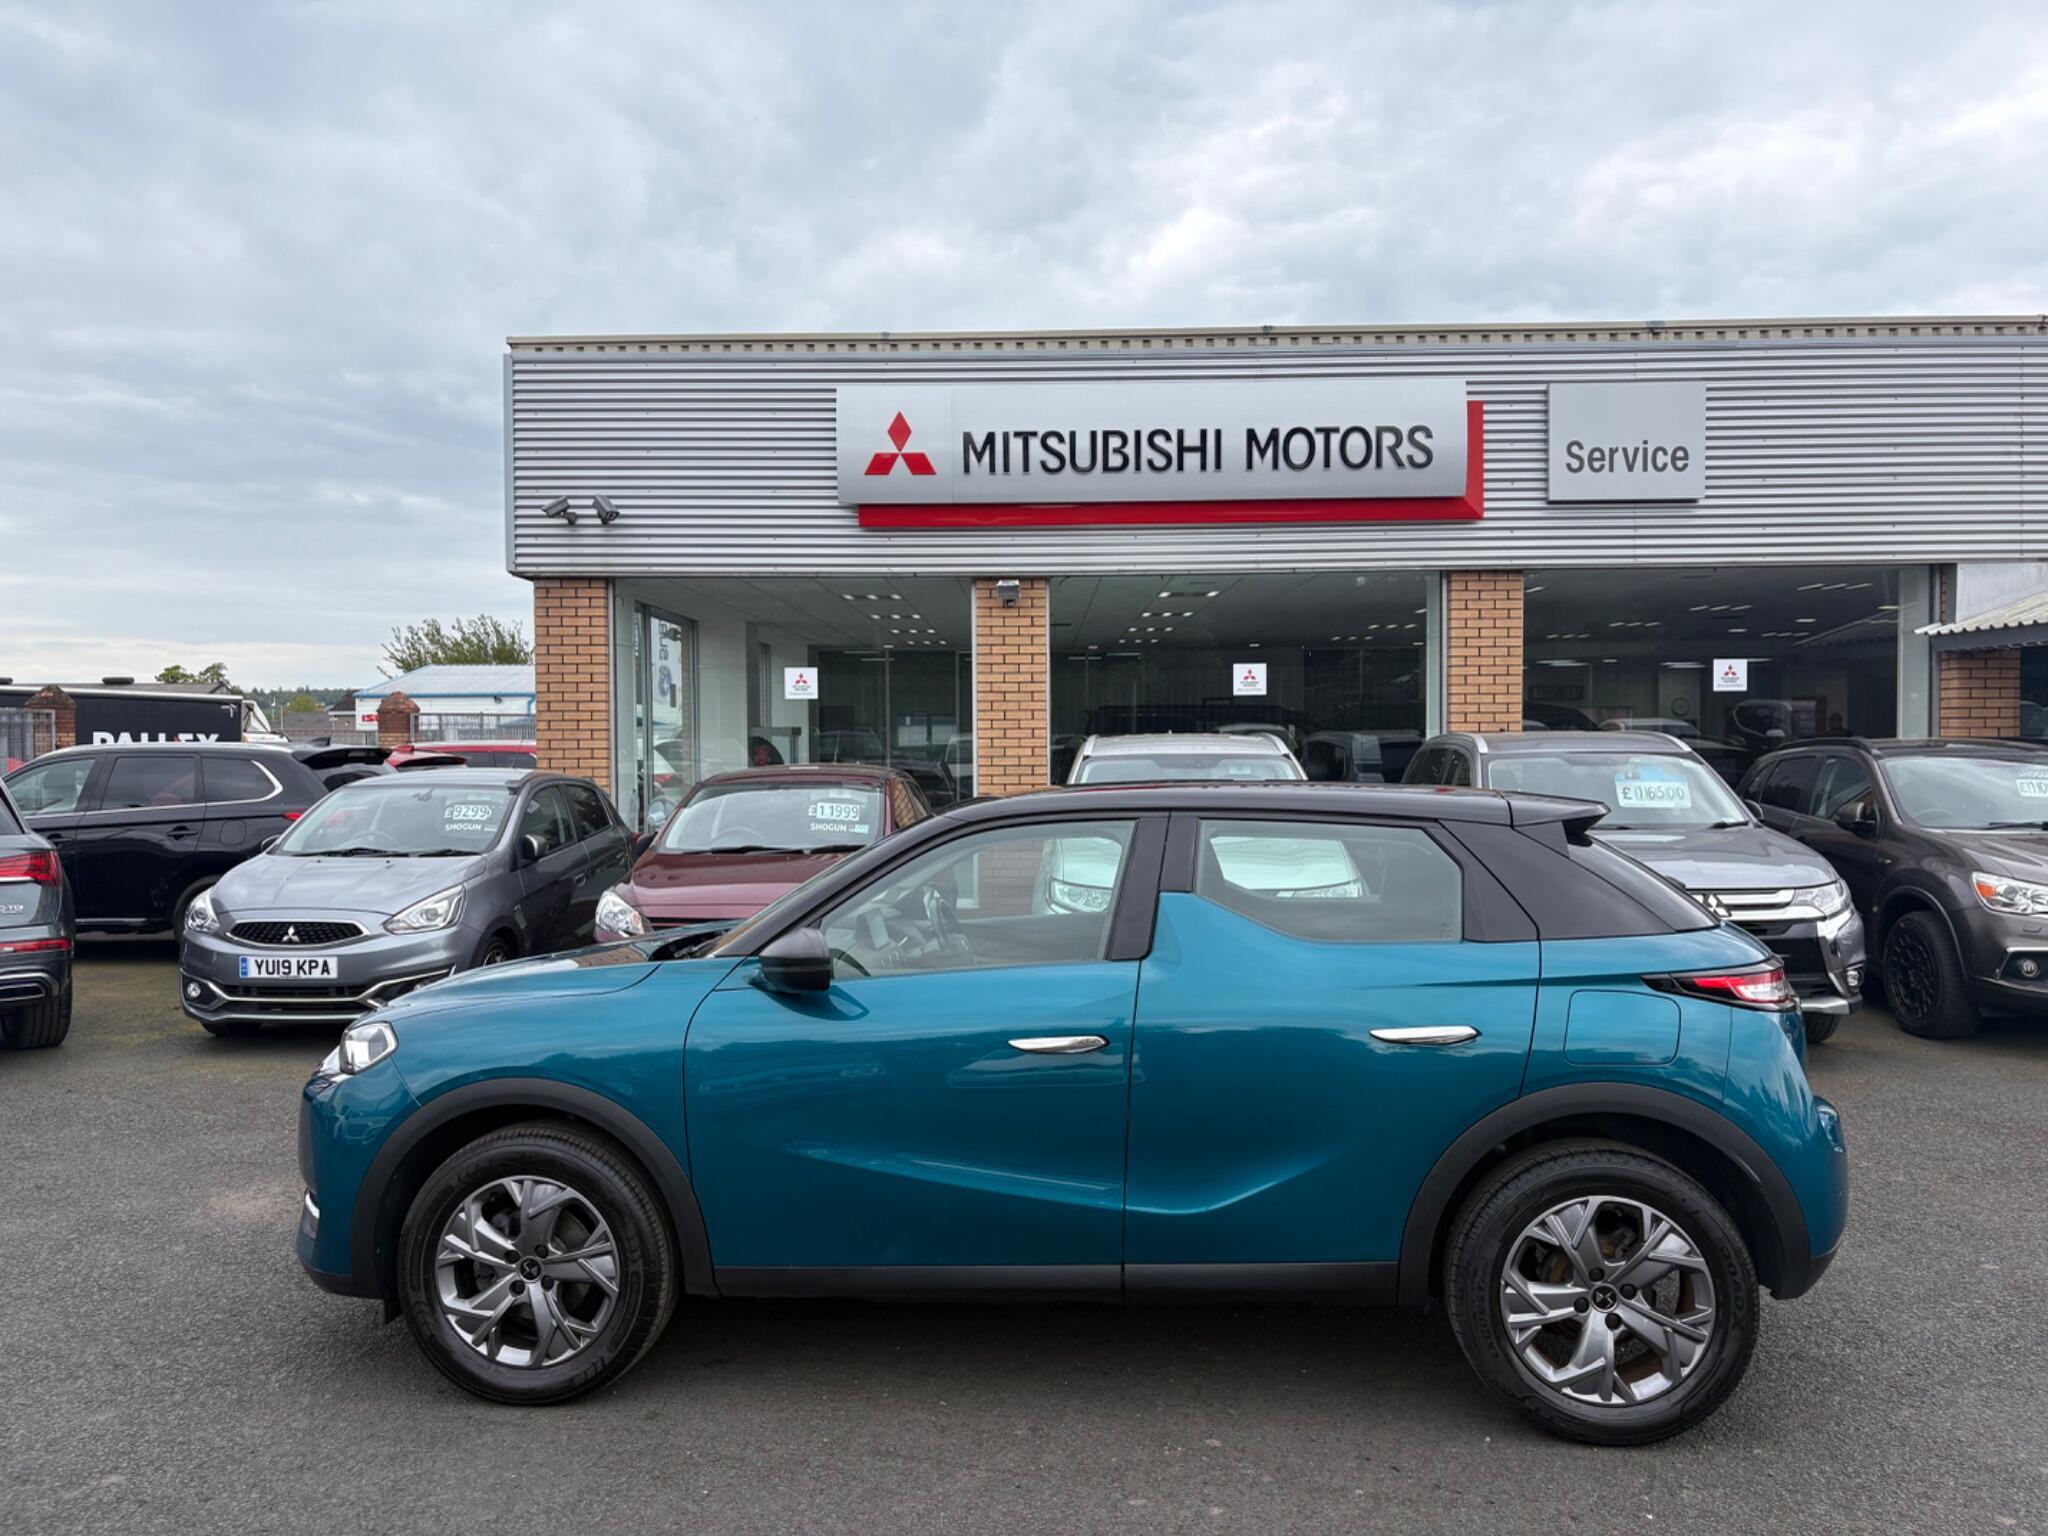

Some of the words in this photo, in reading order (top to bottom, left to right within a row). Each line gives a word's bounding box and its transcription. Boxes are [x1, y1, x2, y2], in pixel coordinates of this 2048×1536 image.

[962, 428, 1223, 474] MITSUBISHI
[1245, 425, 1434, 471] MOTORS
[1565, 440, 1690, 474] Service
[808, 803, 859, 819] £11999
[810, 822, 847, 832] SHOGUN
[254, 959, 292, 976] YU19
[296, 959, 331, 976] KPA
